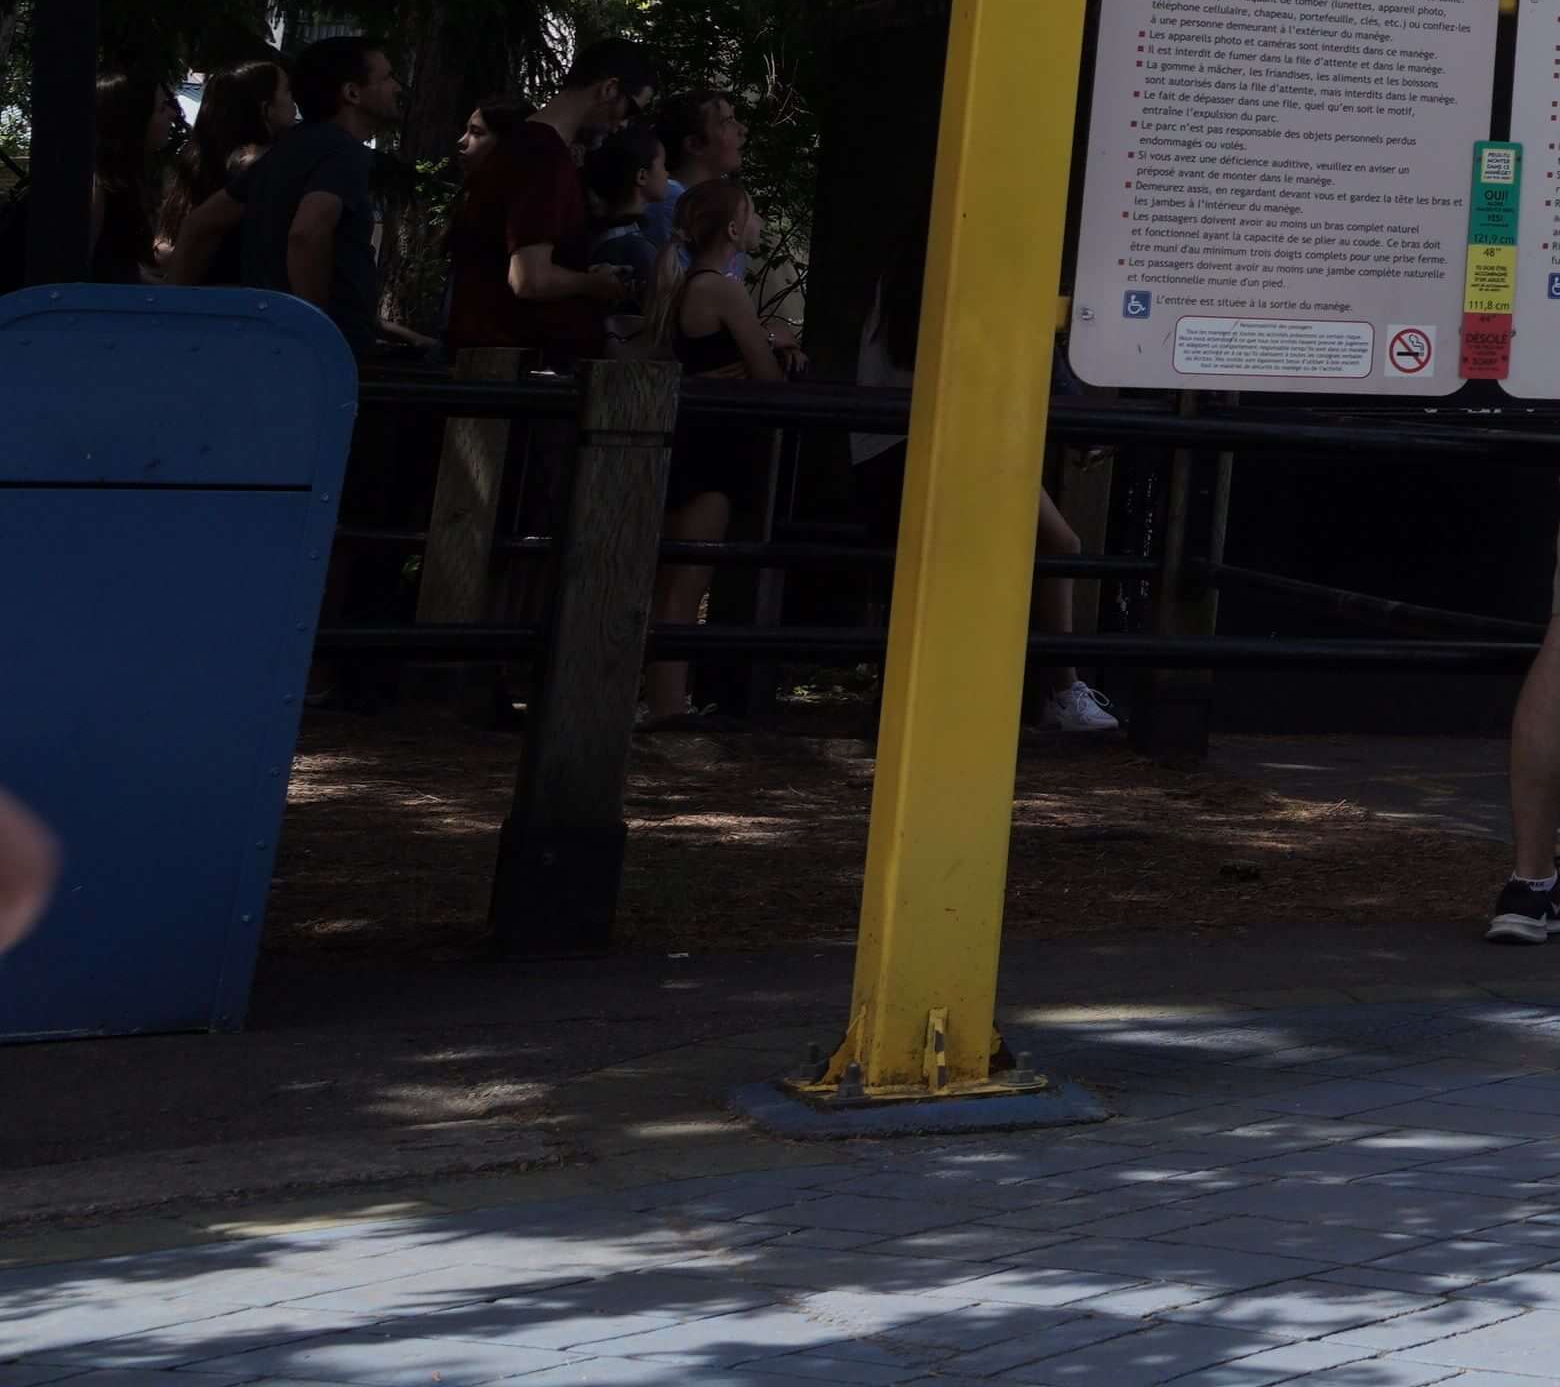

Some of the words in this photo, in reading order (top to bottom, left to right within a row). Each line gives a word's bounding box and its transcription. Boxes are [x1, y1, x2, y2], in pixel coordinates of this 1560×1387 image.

[1148, 29, 1166, 40] Les
[1167, 32, 1213, 44] appareils
[1213, 34, 1243, 46] photo
[1243, 38, 1255, 47] et
[1298, 42, 1318, 52] sont
[1321, 42, 1361, 54] interdits
[1362, 45, 1384, 56] dans
[1385, 48, 1398, 57] ce
[1147, 44, 1155, 55] Il
[1156, 46, 1172, 56] est
[1174, 46, 1212, 59] interdit
[1213, 50, 1226, 60] de
[1228, 50, 1257, 62] fumer
[1259, 53, 1282, 64] dans
[1283, 54, 1293, 64] la
[1295, 55, 1312, 66] file
[1313, 57, 1358, 69] d'attente
[1360, 61, 1371, 70] et
[1372, 60, 1394, 71] dans
[1396, 62, 1406, 72] le
[1473, 234, 1498, 245] 121,9
[1499, 235, 1514, 244] cm
[1199, 298, 1215, 307] est
[1258, 298, 1267, 309] la
[1269, 300, 1297, 310] sortie
[1299, 300, 1312, 311] du
[1468, 300, 1493, 311] 111,8
[1495, 302, 1510, 311] cm
